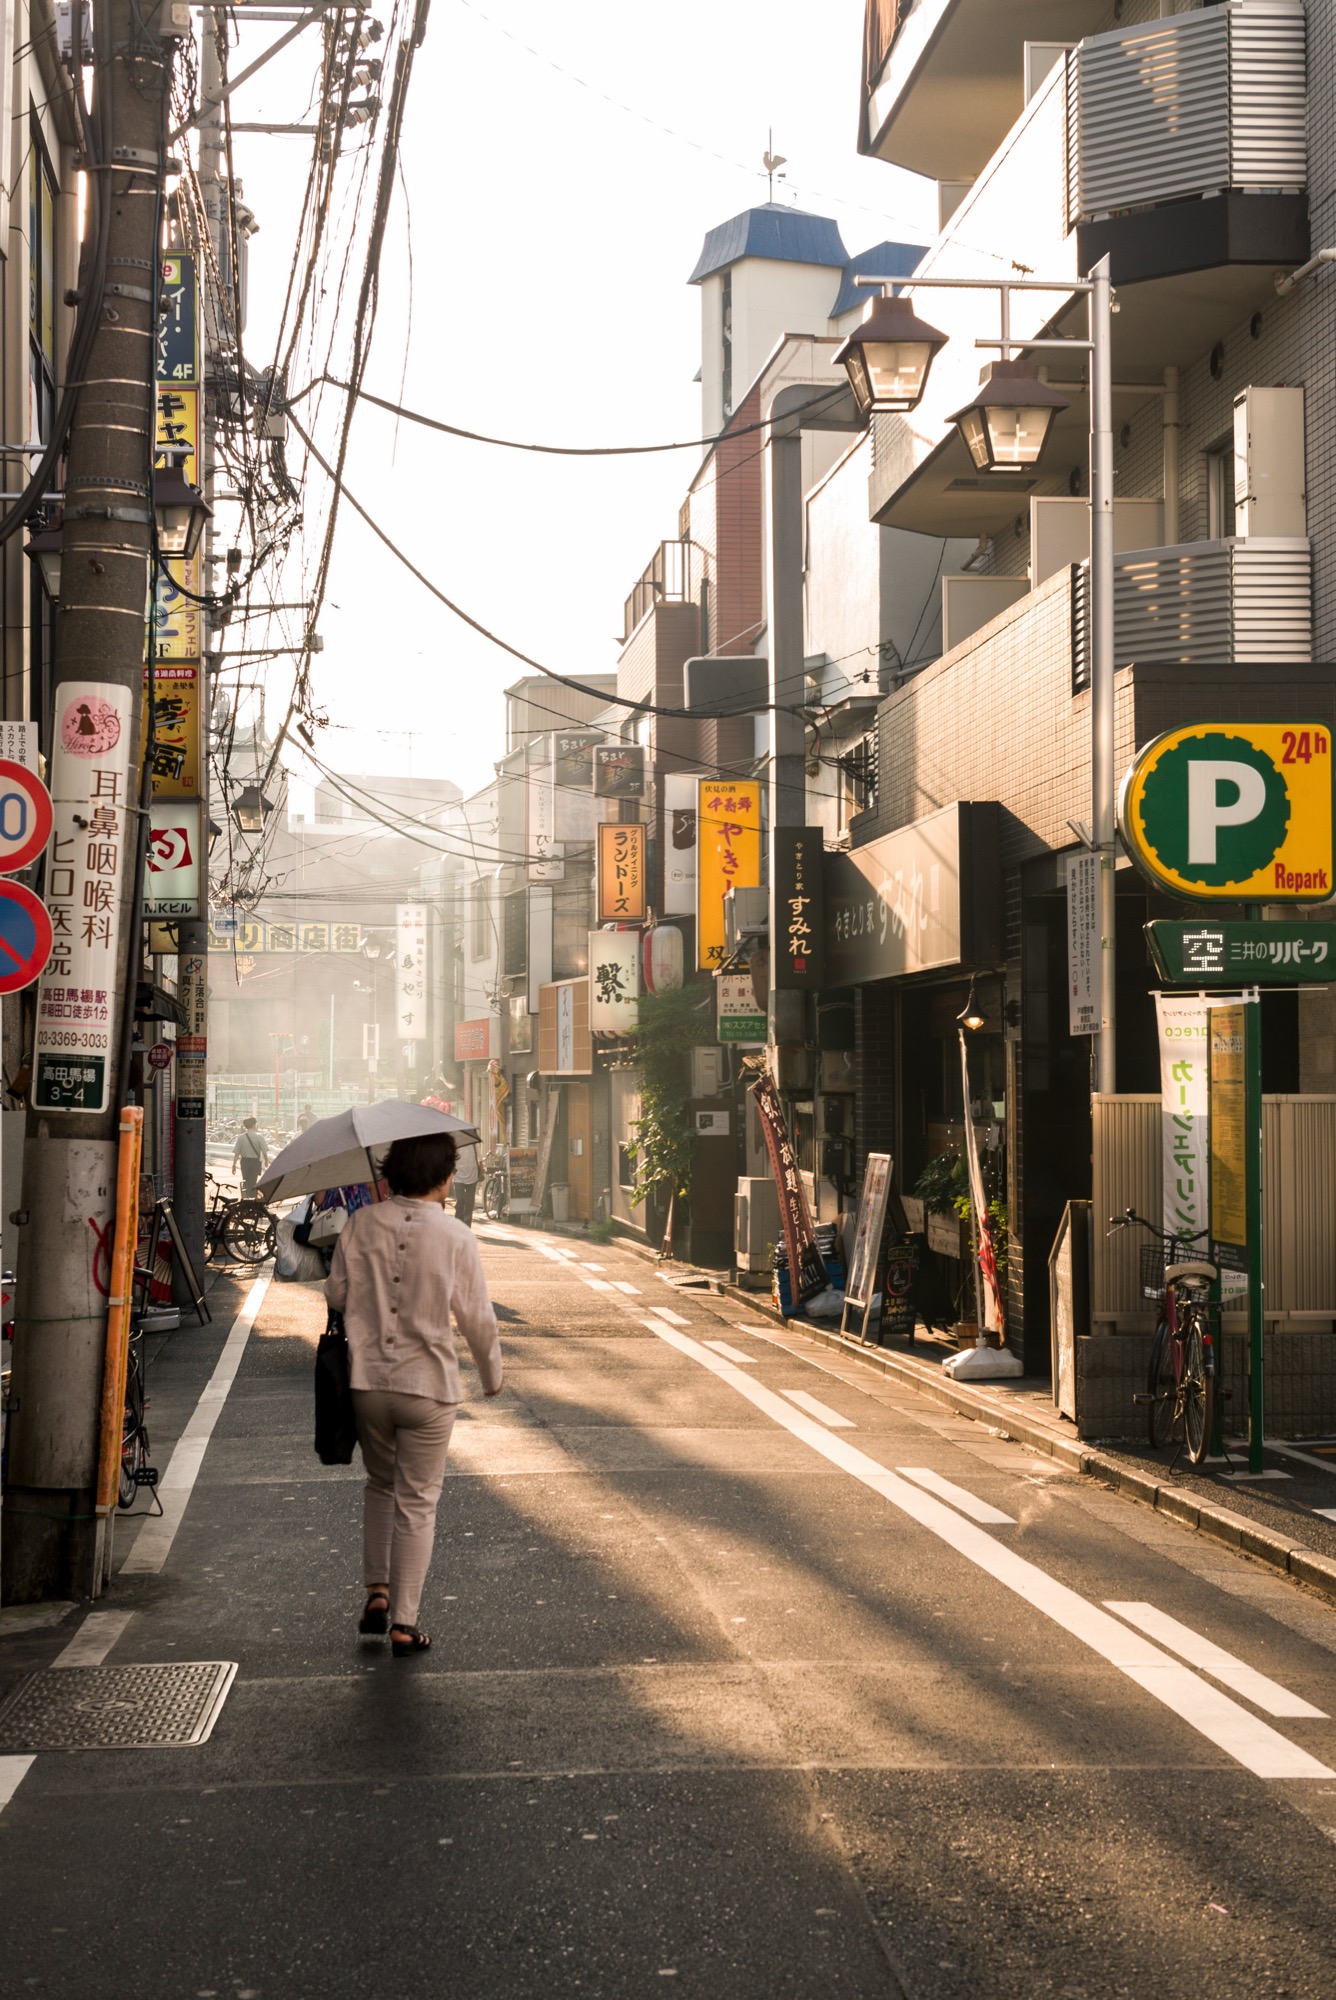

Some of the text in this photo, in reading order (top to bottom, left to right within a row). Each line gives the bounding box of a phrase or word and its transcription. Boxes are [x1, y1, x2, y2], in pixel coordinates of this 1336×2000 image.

[173, 363, 193, 379] 4F
[185, 612, 196, 657] ラフェル
[60, 734, 89, 750] Hiro
[560, 738, 586, 752] Bar
[600, 751, 626, 763] Bar
[1282, 731, 1327, 764] 24h
[705, 785, 736, 793] 伏見の酒
[1187, 760, 1267, 865] P
[81, 769, 123, 949] 耳鼻咽喉科
[613, 831, 630, 912] ランドーズ
[630, 829, 639, 888] グリルダイニング
[1274, 862, 1328, 892] Repark
[43, 830, 75, 975] ヒロ医院
[144, 902, 192, 914] MKビル
[876, 858, 929, 946] すみれ
[788, 895, 812, 955] すみれ
[1183, 929, 1225, 972] 空
[1230, 939, 1328, 964] 三井のリパーク
[43, 987, 107, 1004] 高田馬場駅
[195, 976, 204, 1009] 上落合
[40, 1003, 108, 1020] 早稲田口徒歩1分
[38, 1031, 108, 1049] 03-3369-3033
[43, 1066, 96, 1083] 高田馬場
